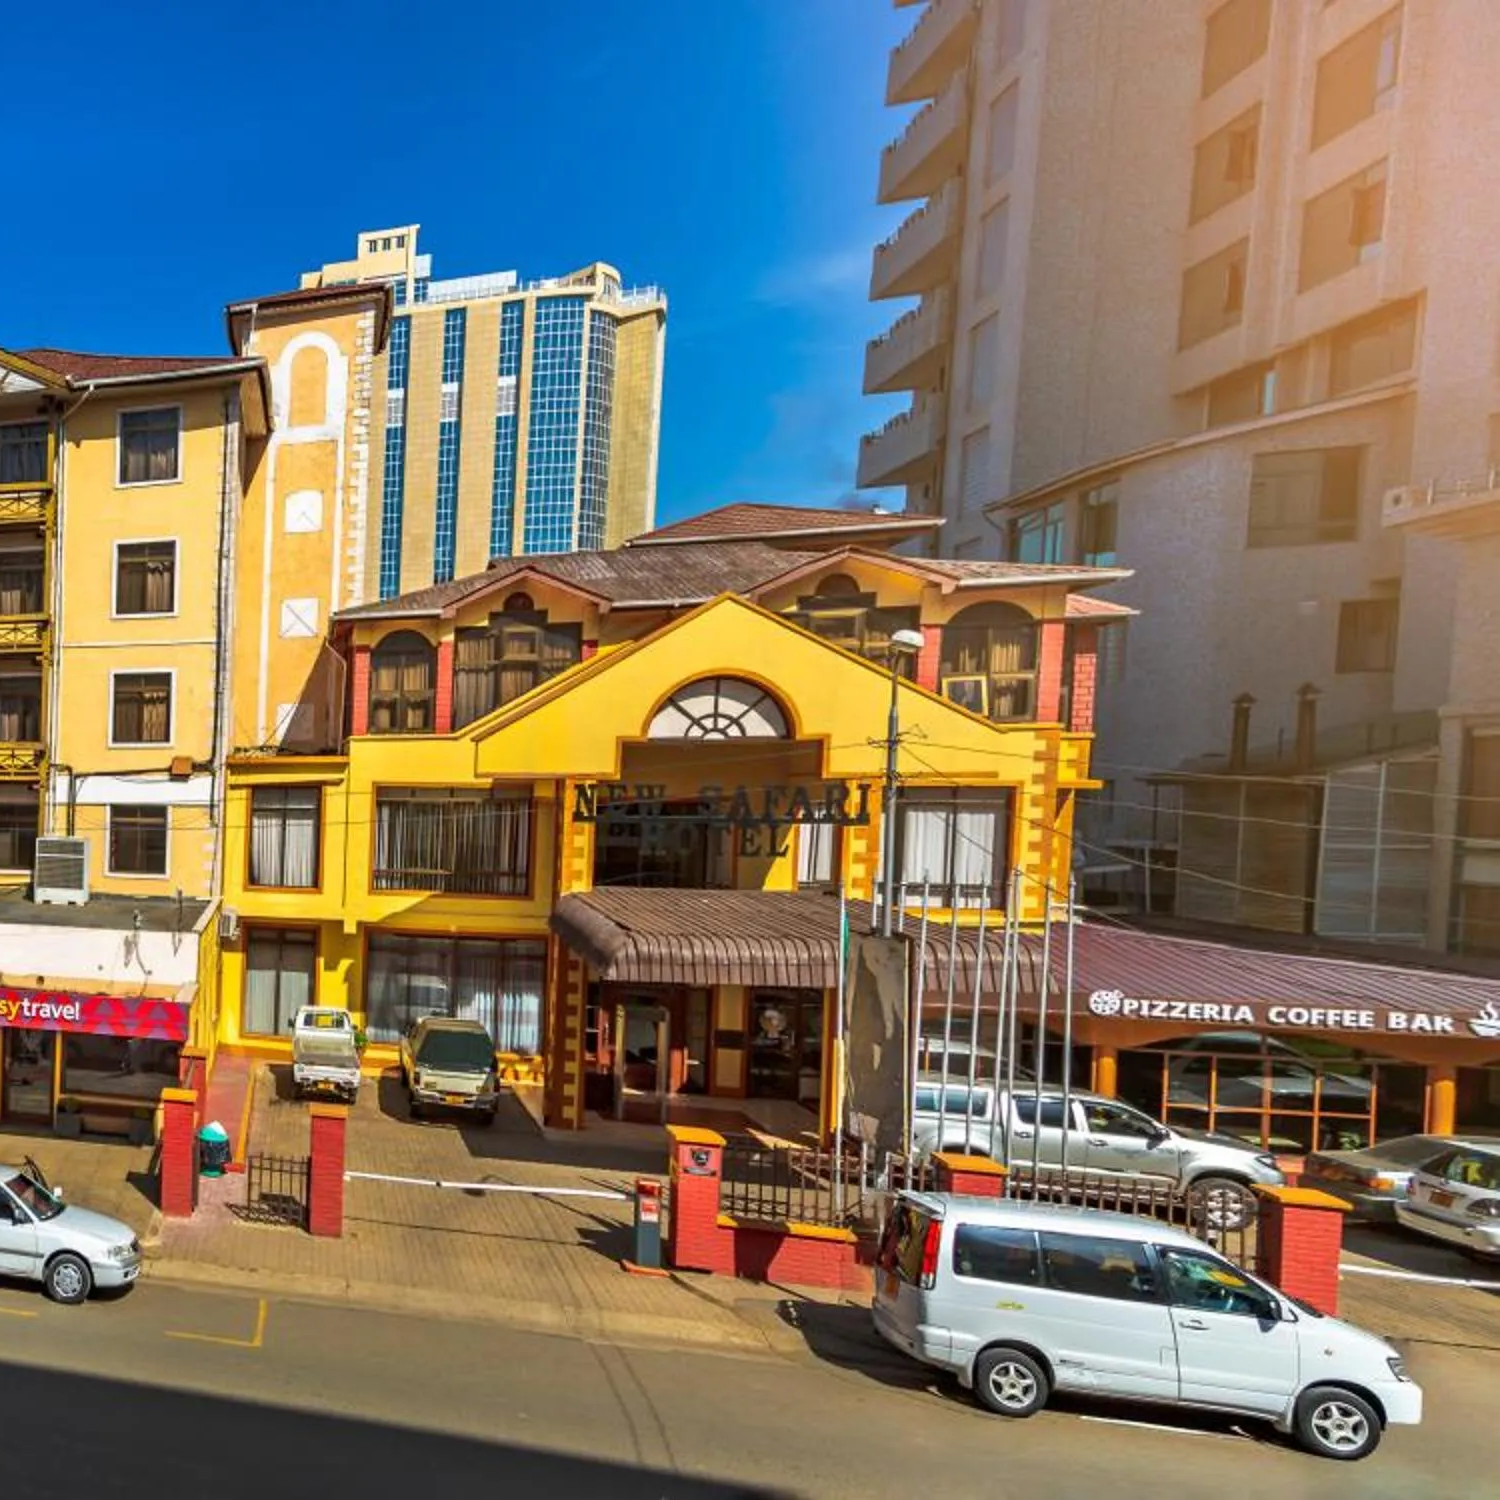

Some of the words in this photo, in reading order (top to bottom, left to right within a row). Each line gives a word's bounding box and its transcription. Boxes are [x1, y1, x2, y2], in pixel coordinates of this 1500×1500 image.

[573, 783, 667, 822] NEW
[702, 783, 870, 826] SAFARI
[640, 820, 791, 858] HOTEL
[1122, 998, 1254, 1023] PIZZERIA
[1267, 1005, 1374, 1029] COFFEE
[1388, 1011, 1454, 1033] BAR
